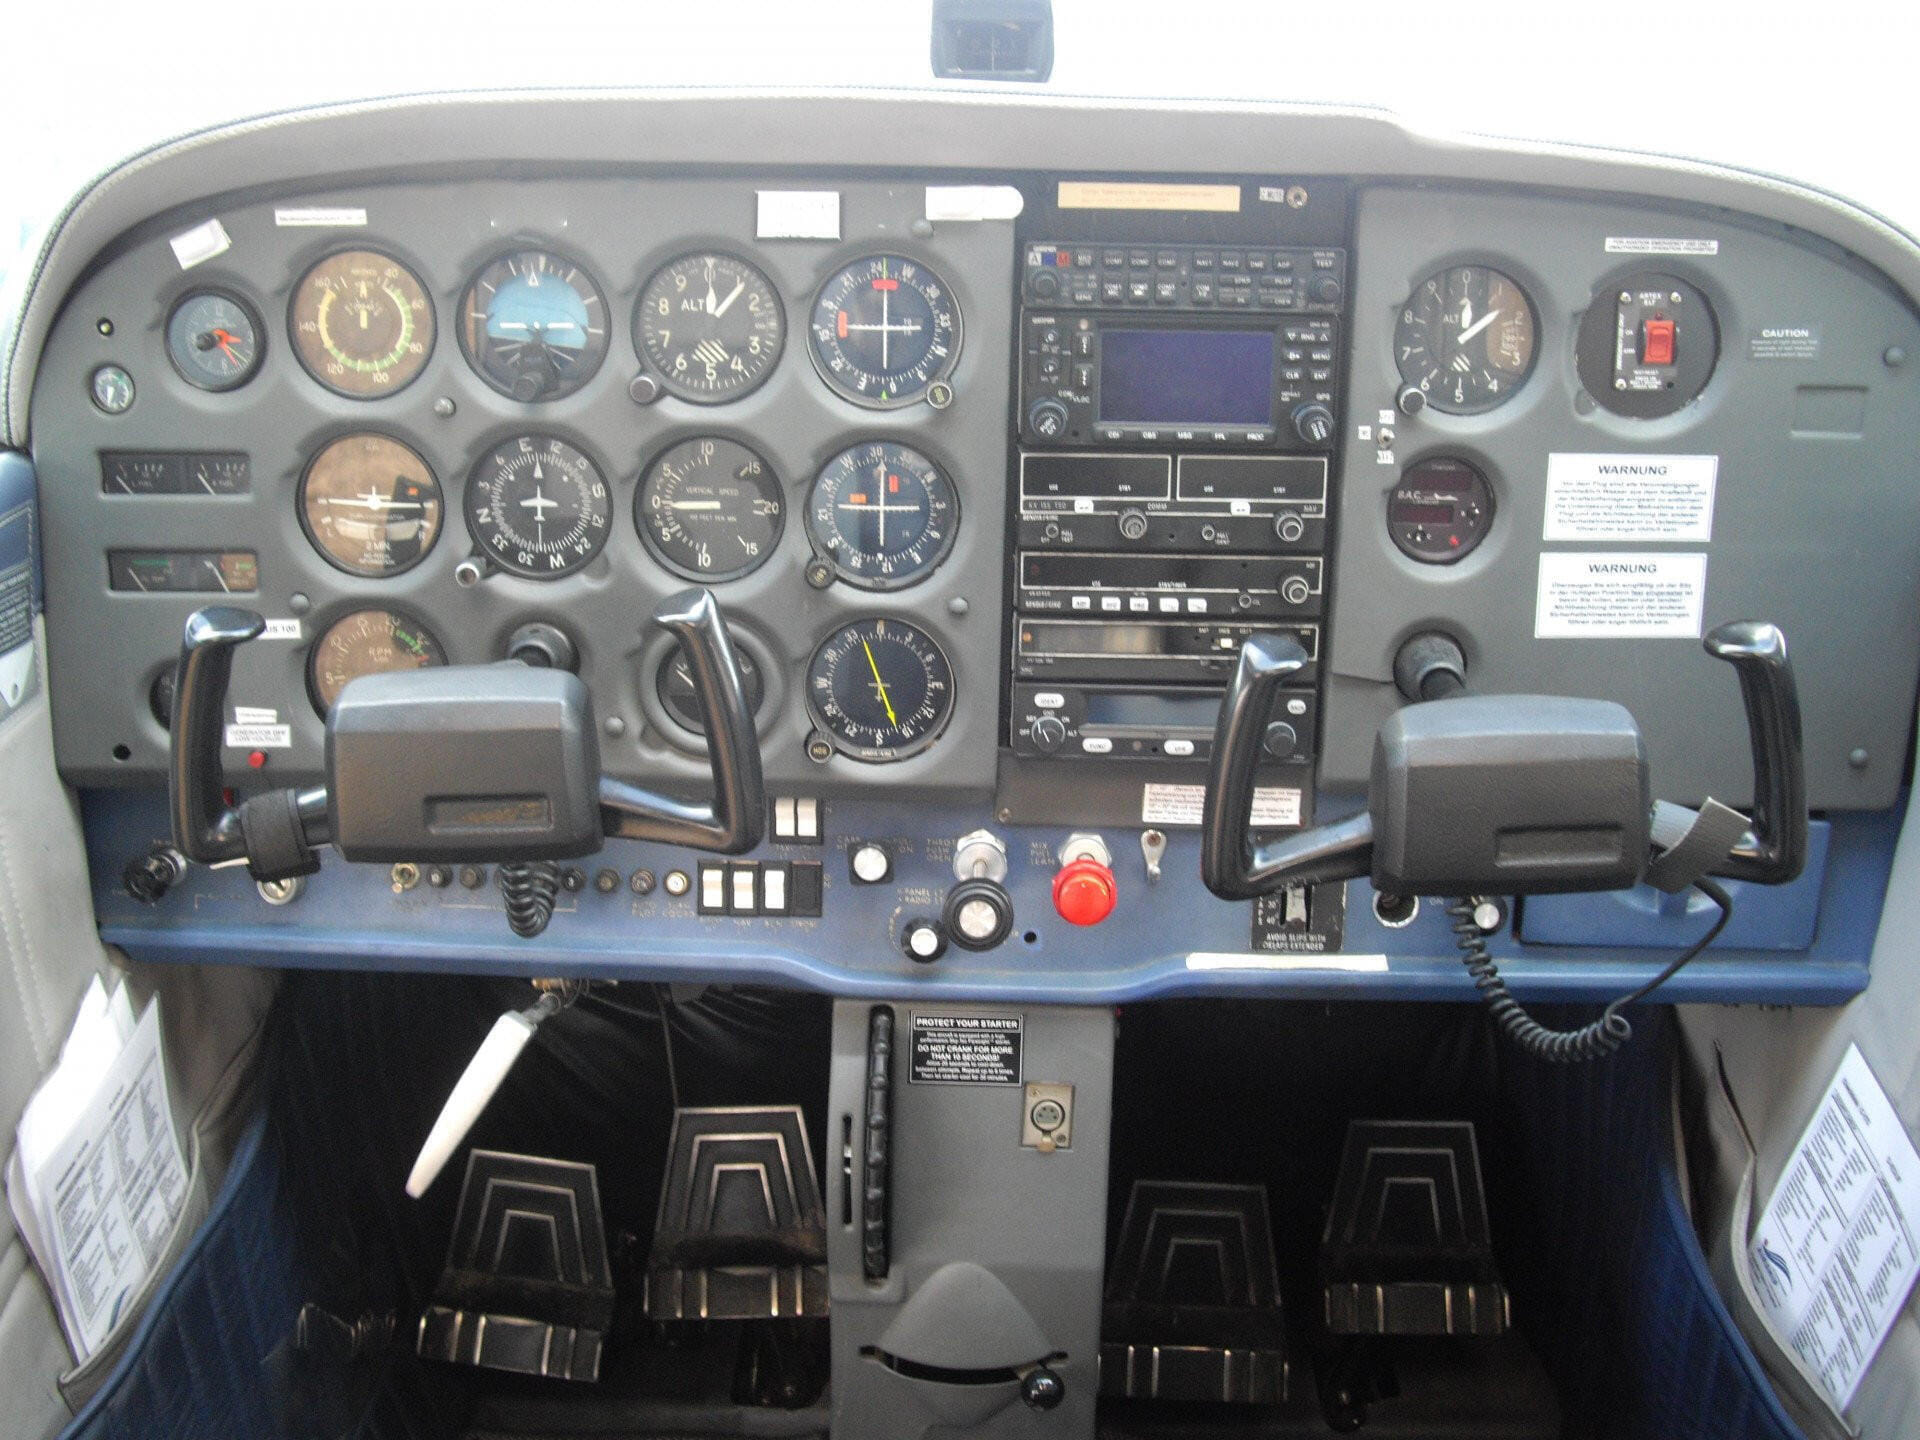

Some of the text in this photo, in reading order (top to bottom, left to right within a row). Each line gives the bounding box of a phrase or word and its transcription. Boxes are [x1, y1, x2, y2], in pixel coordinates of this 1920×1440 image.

[314, 277, 331, 288] 160
[675, 274, 687, 292] 9
[1462, 270, 1471, 284] 0
[1427, 280, 1437, 293] 9
[659, 297, 670, 316] 8
[681, 298, 705, 312] ALT
[749, 293, 760, 312] 2
[1404, 309, 1413, 324] 8
[1443, 314, 1459, 324] ALT
[299, 322, 316, 332] 140
[1762, 329, 1809, 338] CAUTION
[659, 330, 671, 348] 7
[749, 336, 760, 355] 3
[1402, 346, 1411, 361] 7
[1511, 351, 1521, 366] 3
[327, 363, 344, 374] 120
[675, 353, 688, 371] 6
[730, 354, 744, 371] 4
[372, 373, 389, 383] 100
[705, 362, 717, 381] 5
[1420, 377, 1431, 391] 6
[1488, 378, 1498, 393] 4
[1454, 388, 1464, 403] 5
[518, 437, 533, 453] E
[701, 441, 714, 456] 10
[495, 454, 505, 465] 6
[748, 461, 761, 475] 15
[1598, 465, 1668, 476] WARNUNG
[478, 481, 490, 491] 3
[592, 482, 606, 499] S
[652, 495, 661, 509] 0
[476, 507, 491, 524] N
[592, 514, 605, 528] 21
[662, 527, 672, 542] 5
[492, 533, 509, 552] 33
[574, 537, 592, 555] 24
[746, 542, 758, 556] 15
[518, 551, 534, 566] 30
[549, 553, 566, 569] W
[698, 553, 712, 568] 10
[1588, 563, 1657, 574] WARNUNG
[368, 647, 392, 656] RPM
[916, 1017, 1018, 1029] PROTECT YOUR STARTER
[917, 1044, 1013, 1055] DO NOT CRANK FOR MORE
[931, 1052, 952, 1060] THAN
